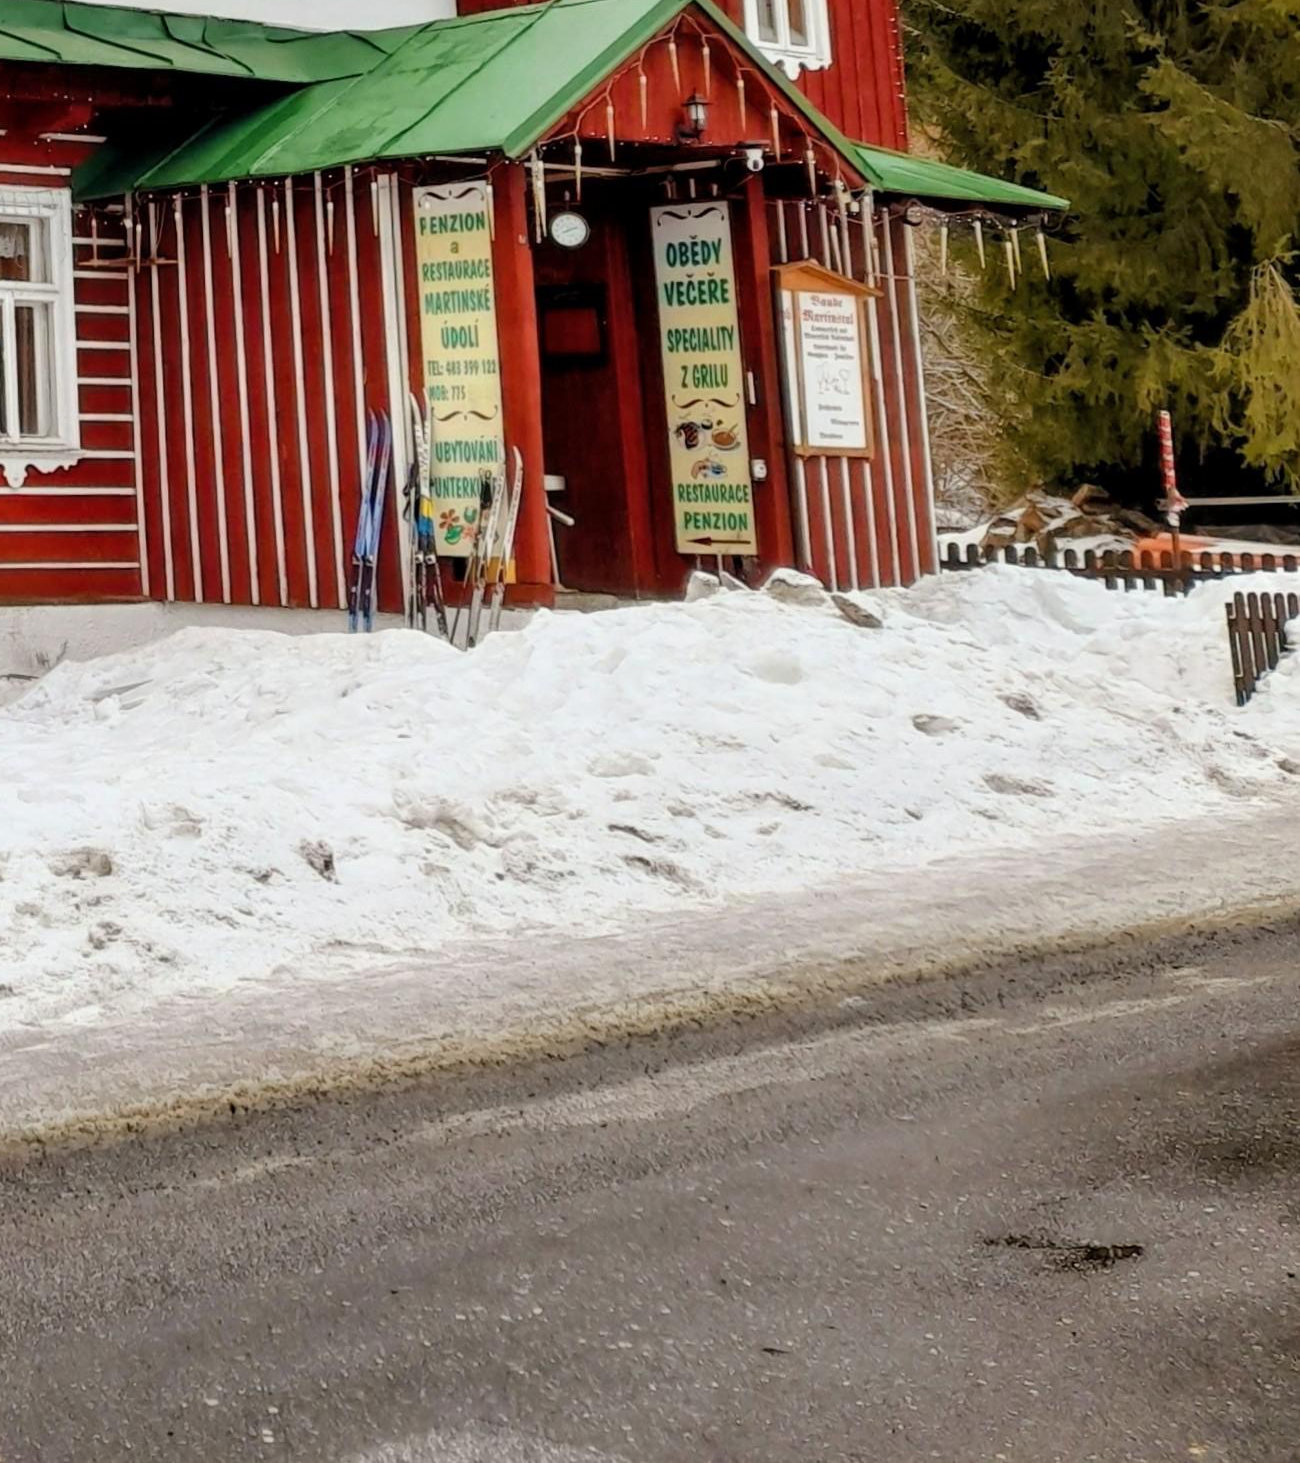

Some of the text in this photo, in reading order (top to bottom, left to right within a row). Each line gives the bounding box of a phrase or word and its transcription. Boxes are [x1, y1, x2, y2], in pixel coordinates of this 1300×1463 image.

[419, 211, 486, 236] PENZION
[449, 241, 460, 254] a
[666, 235, 722, 267] OBĚDY
[422, 258, 491, 283] RESTAURACE
[424, 283, 491, 315] MARTINSKÉ
[664, 272, 729, 306] VEČEŘE
[441, 318, 480, 349] ÚDOLÍ
[667, 325, 734, 353] SPECIALITY
[681, 363, 728, 389] Z GRILU
[435, 435, 498, 463] UBYTOVÁNÍ
[677, 483, 750, 503] RESTAURACE
[684, 511, 748, 531] PENZION
